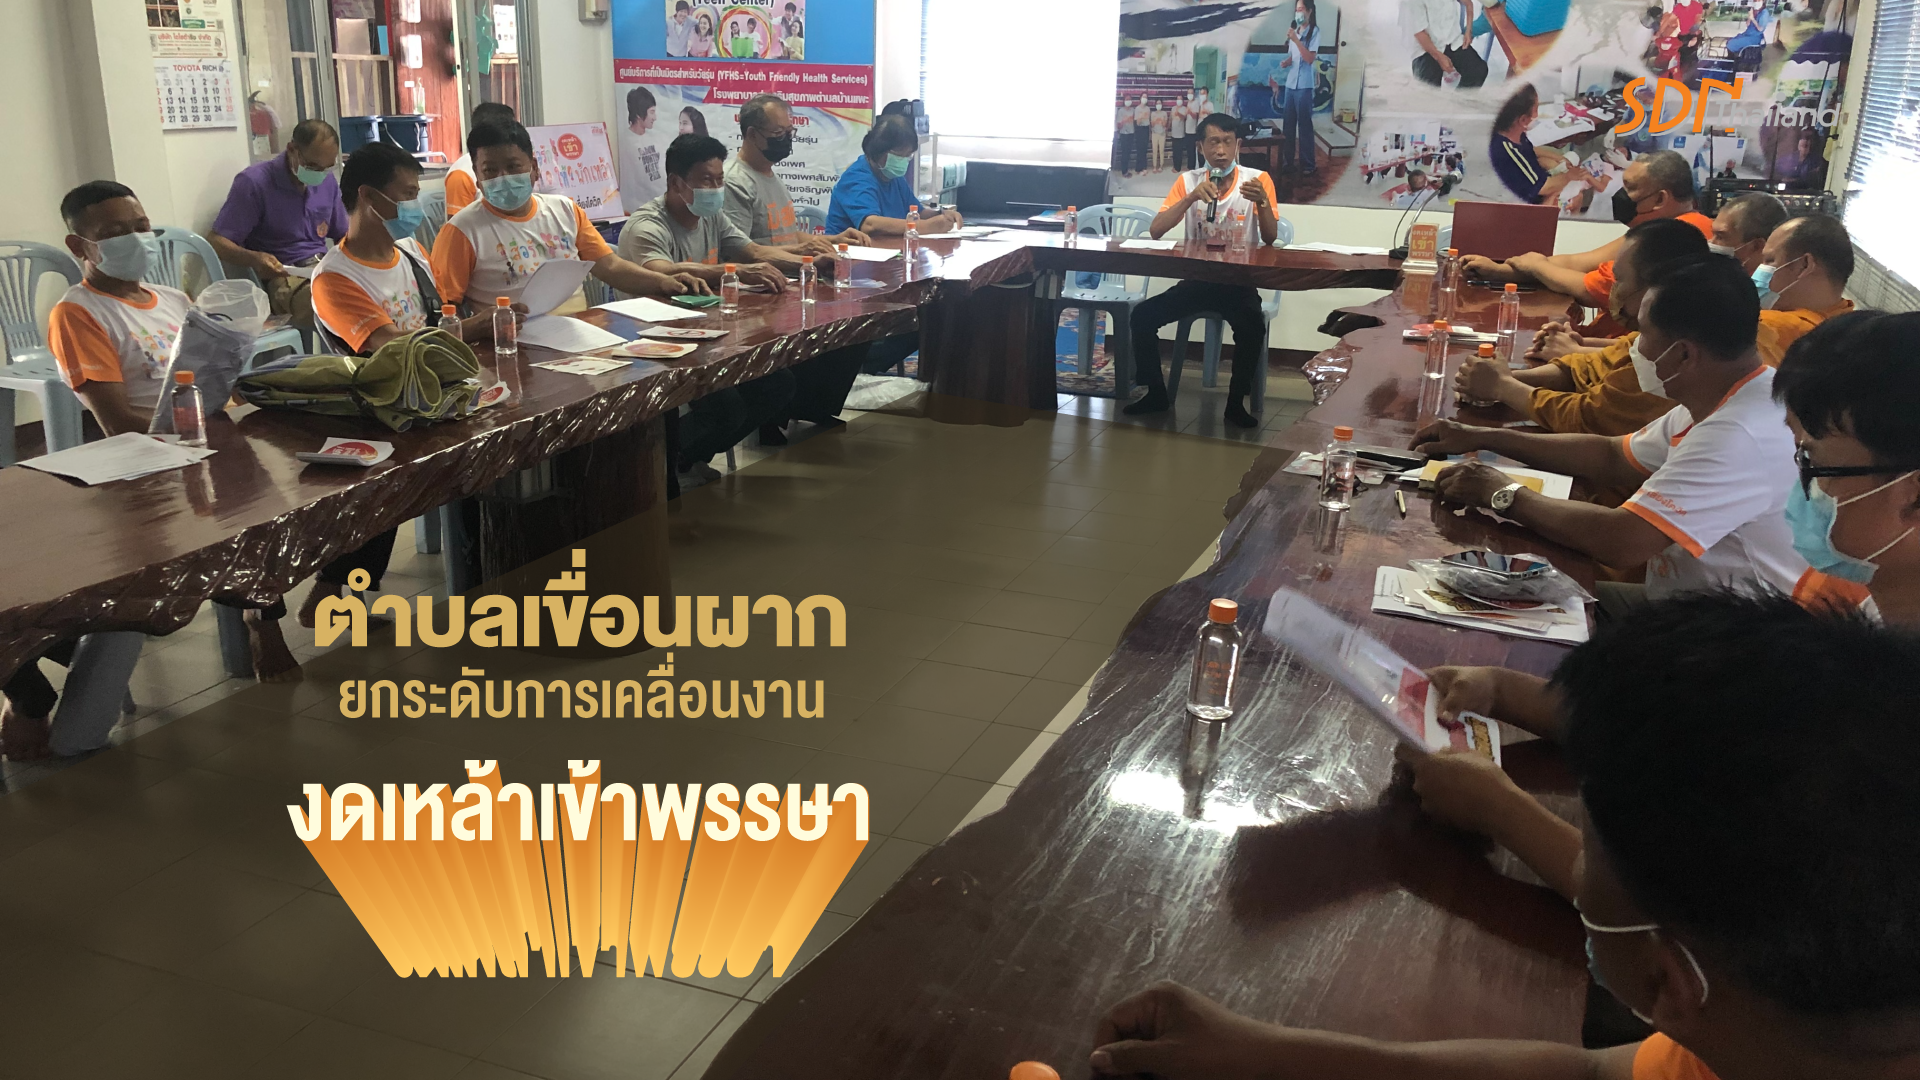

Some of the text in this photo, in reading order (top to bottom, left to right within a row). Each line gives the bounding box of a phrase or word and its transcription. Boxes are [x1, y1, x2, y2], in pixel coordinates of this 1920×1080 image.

[769, 72, 800, 84] Friendly
[803, 73, 828, 83] Health
[831, 74, 868, 86] Services)
